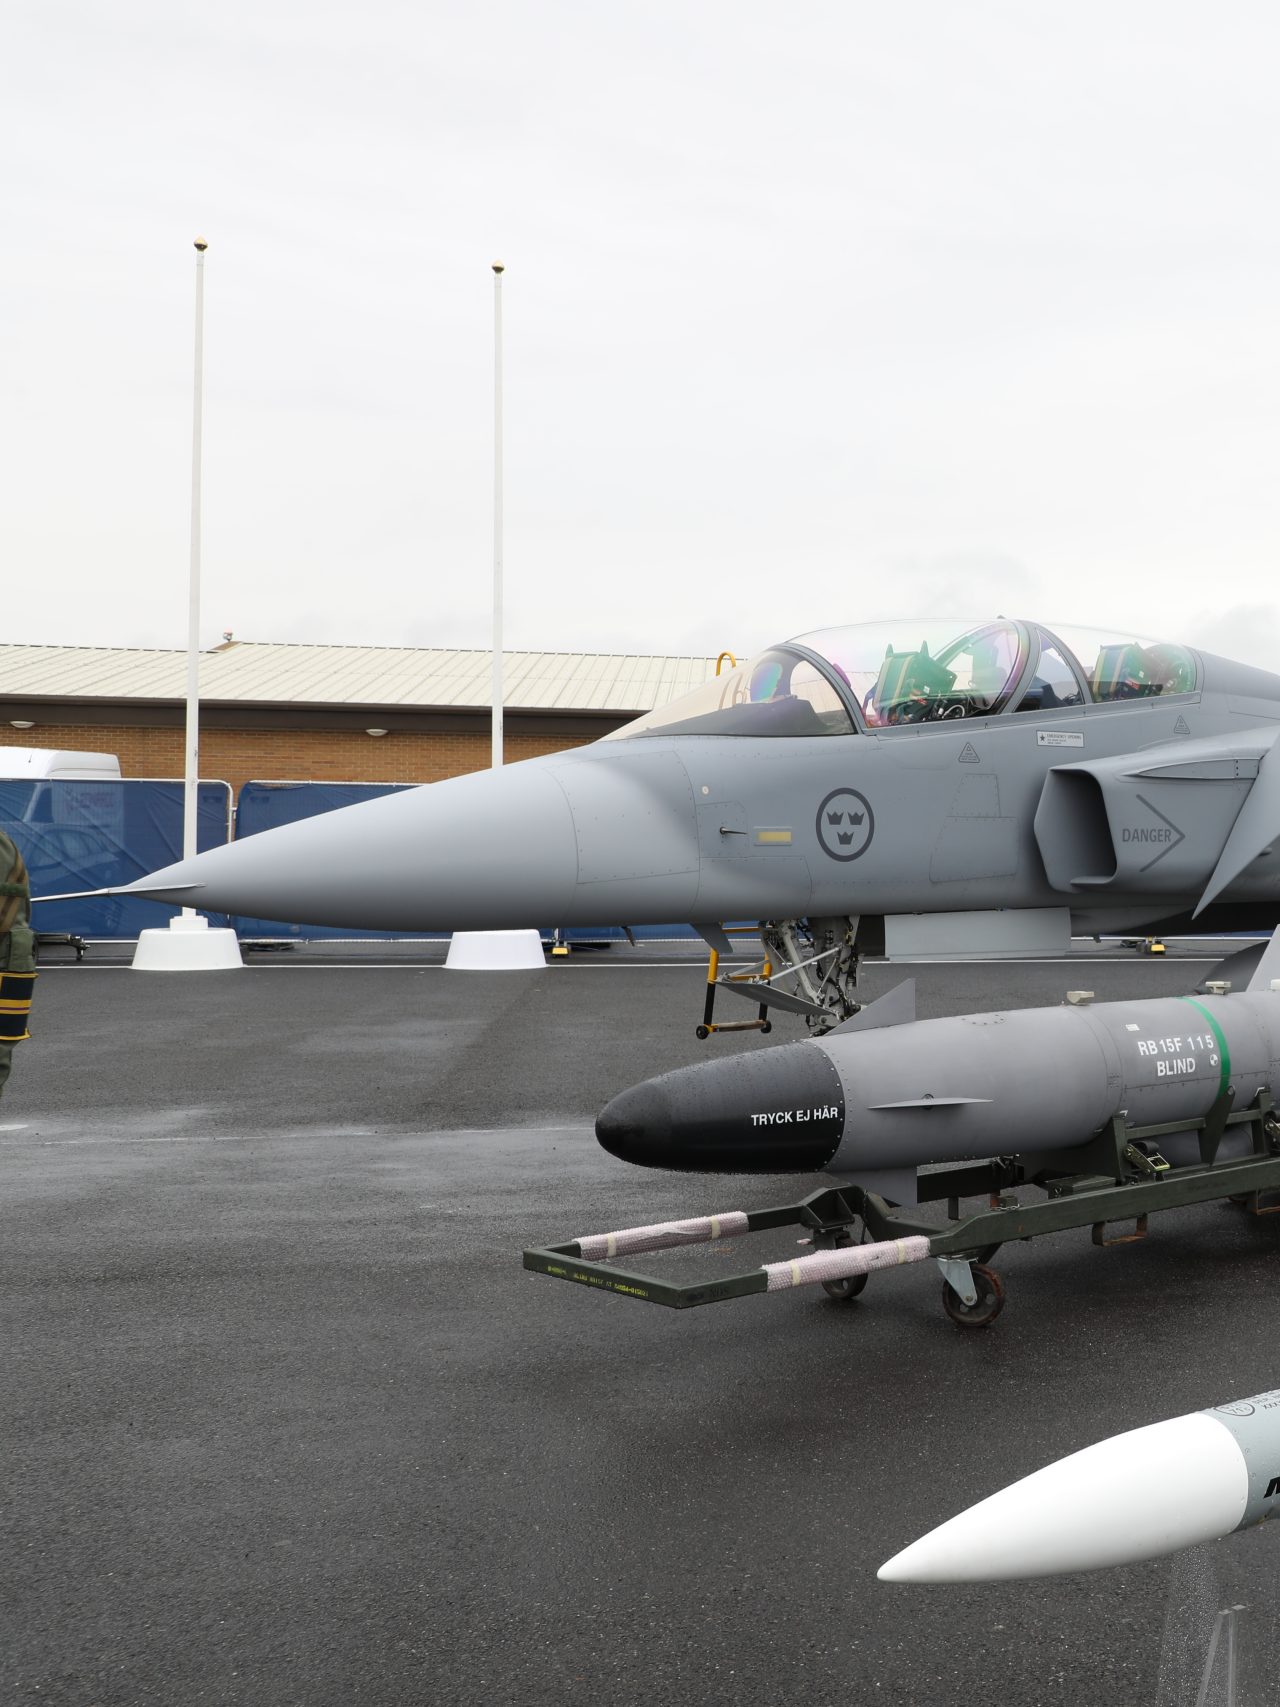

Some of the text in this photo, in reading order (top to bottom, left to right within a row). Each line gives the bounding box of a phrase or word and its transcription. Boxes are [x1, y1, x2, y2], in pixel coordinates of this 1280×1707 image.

[1122, 828, 1171, 842] DANGER
[1156, 1057, 1196, 1077] BLIND
[751, 1105, 838, 1126] TRYCK EJ HÄR
